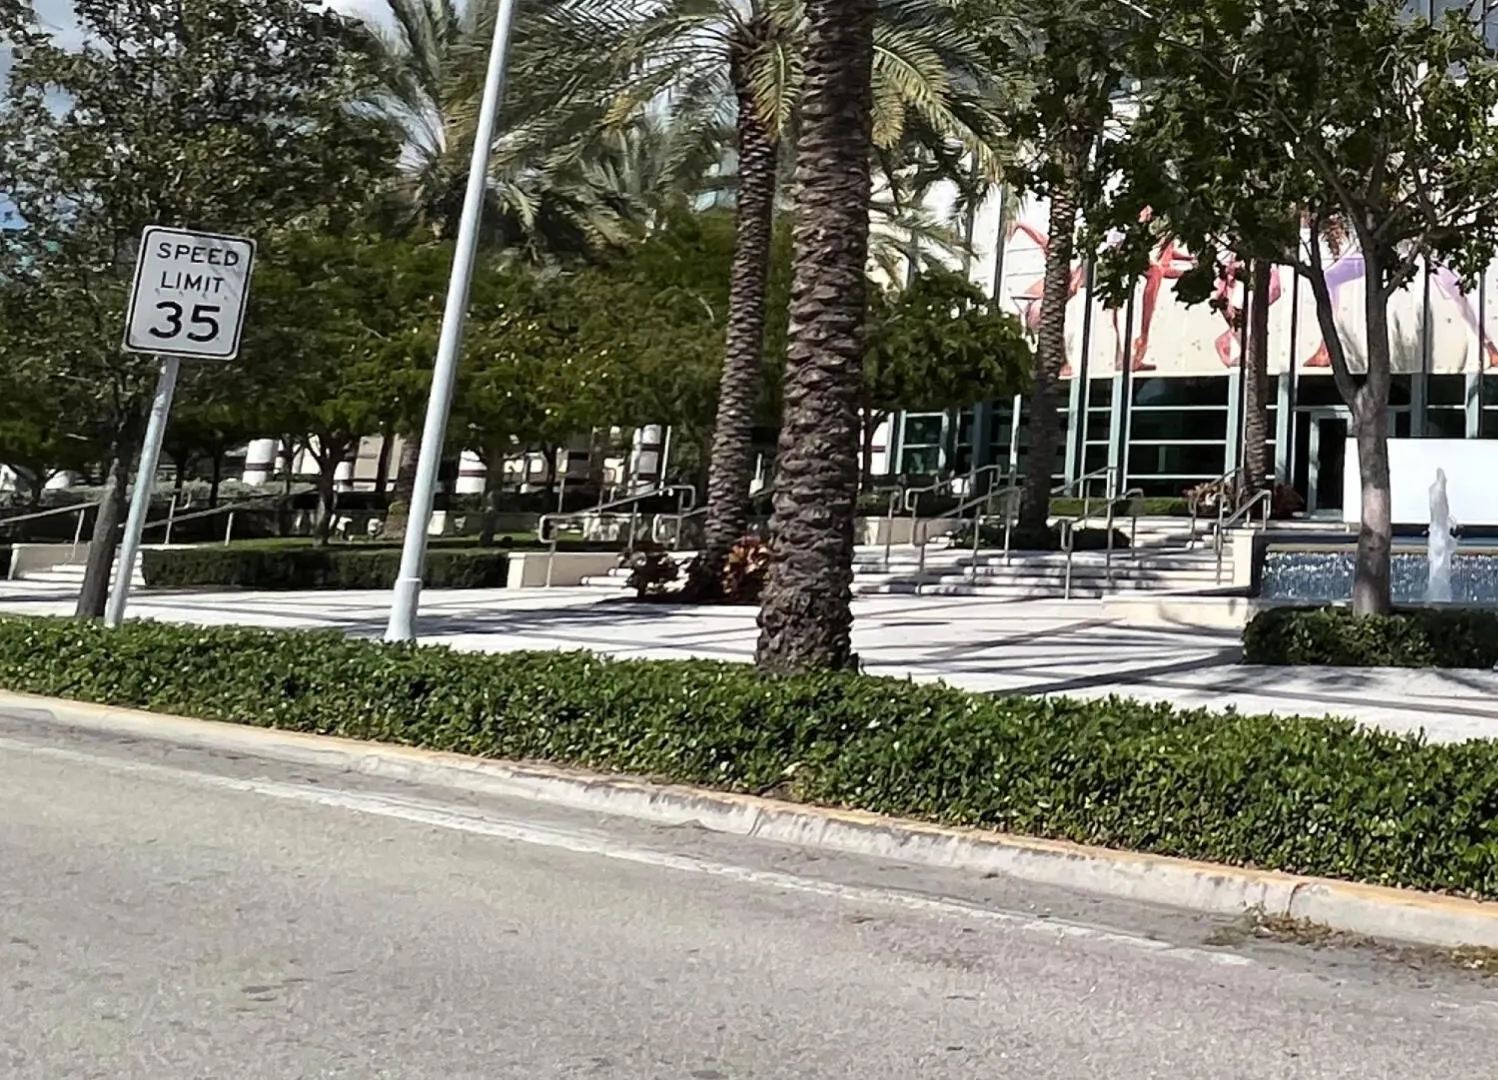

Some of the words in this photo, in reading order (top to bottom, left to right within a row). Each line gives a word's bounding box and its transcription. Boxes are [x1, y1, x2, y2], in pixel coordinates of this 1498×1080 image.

[156, 241, 240, 267] SPEED
[160, 270, 225, 294] LIMIT
[148, 301, 221, 343] 35
